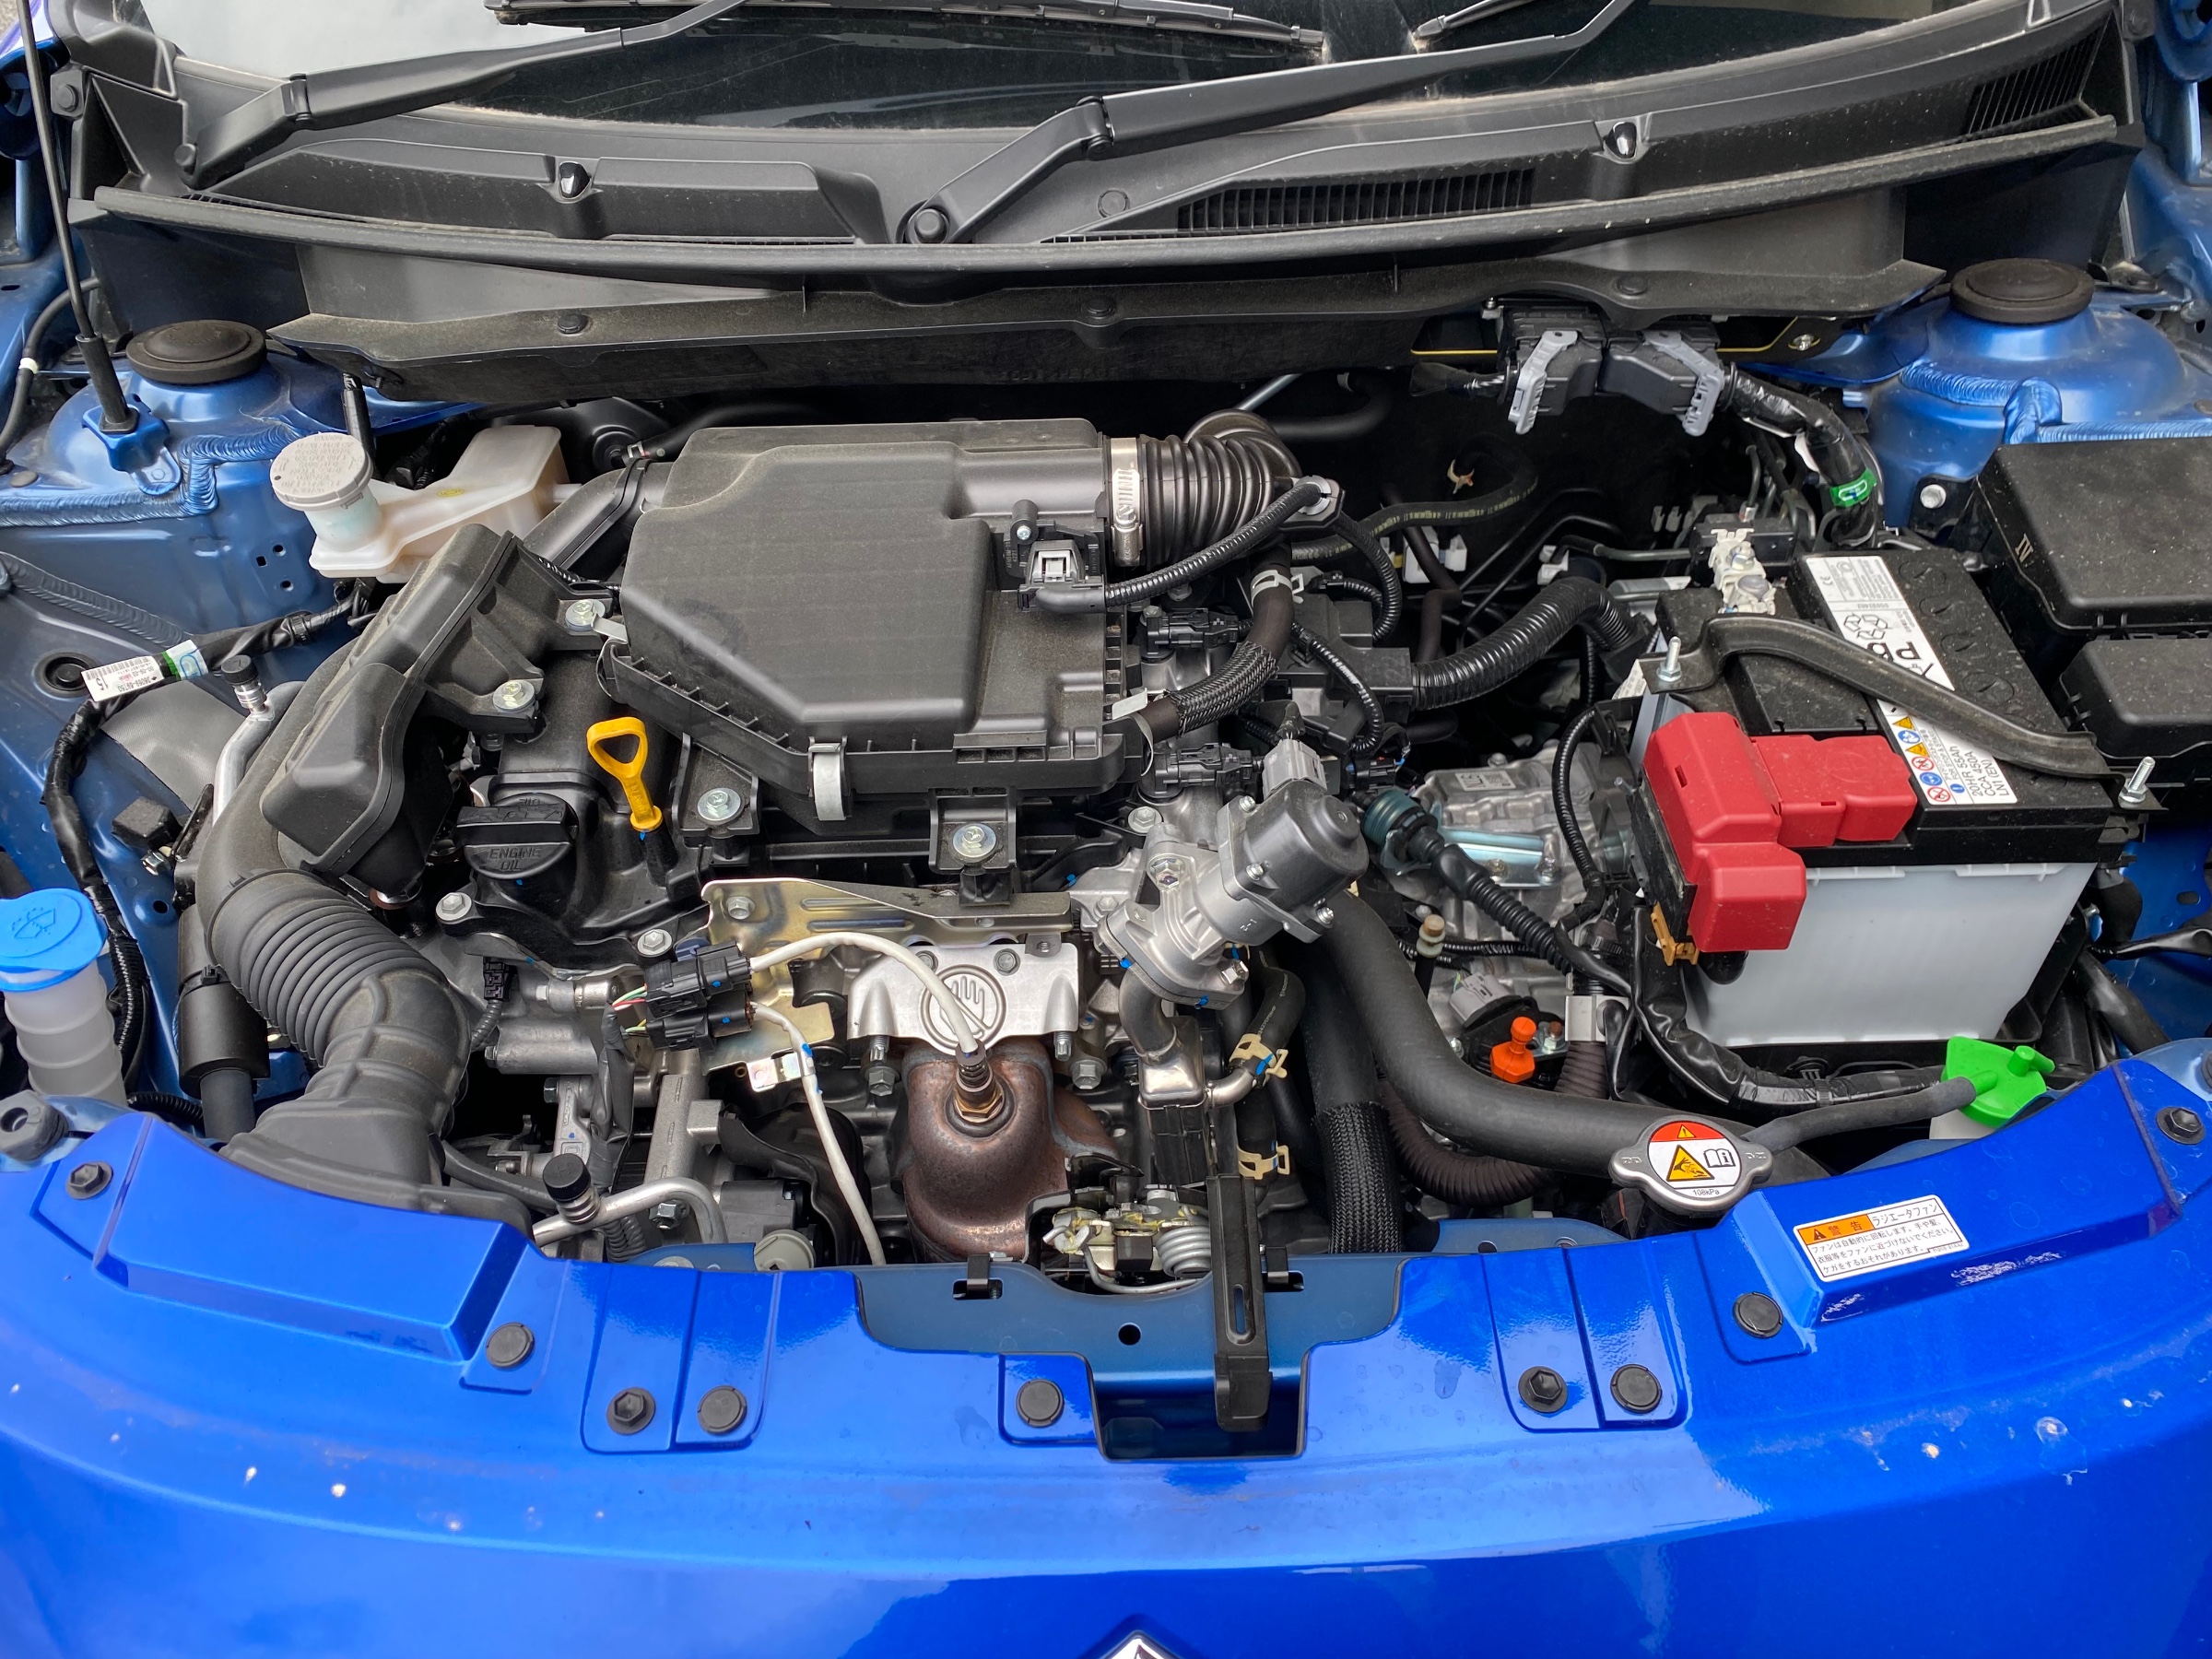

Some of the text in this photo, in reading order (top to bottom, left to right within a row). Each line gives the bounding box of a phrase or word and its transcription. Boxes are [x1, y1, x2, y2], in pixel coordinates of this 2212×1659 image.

[1949, 746, 1983, 796] 20HR 55Ah
[1964, 751, 1995, 796] CCA 450A
[1982, 759, 2009, 796] LN1 (EN)
[488, 846, 543, 859] ENGINE
[500, 859, 523, 871] OIL
[1872, 1203, 1938, 1226] ラジエータファン
